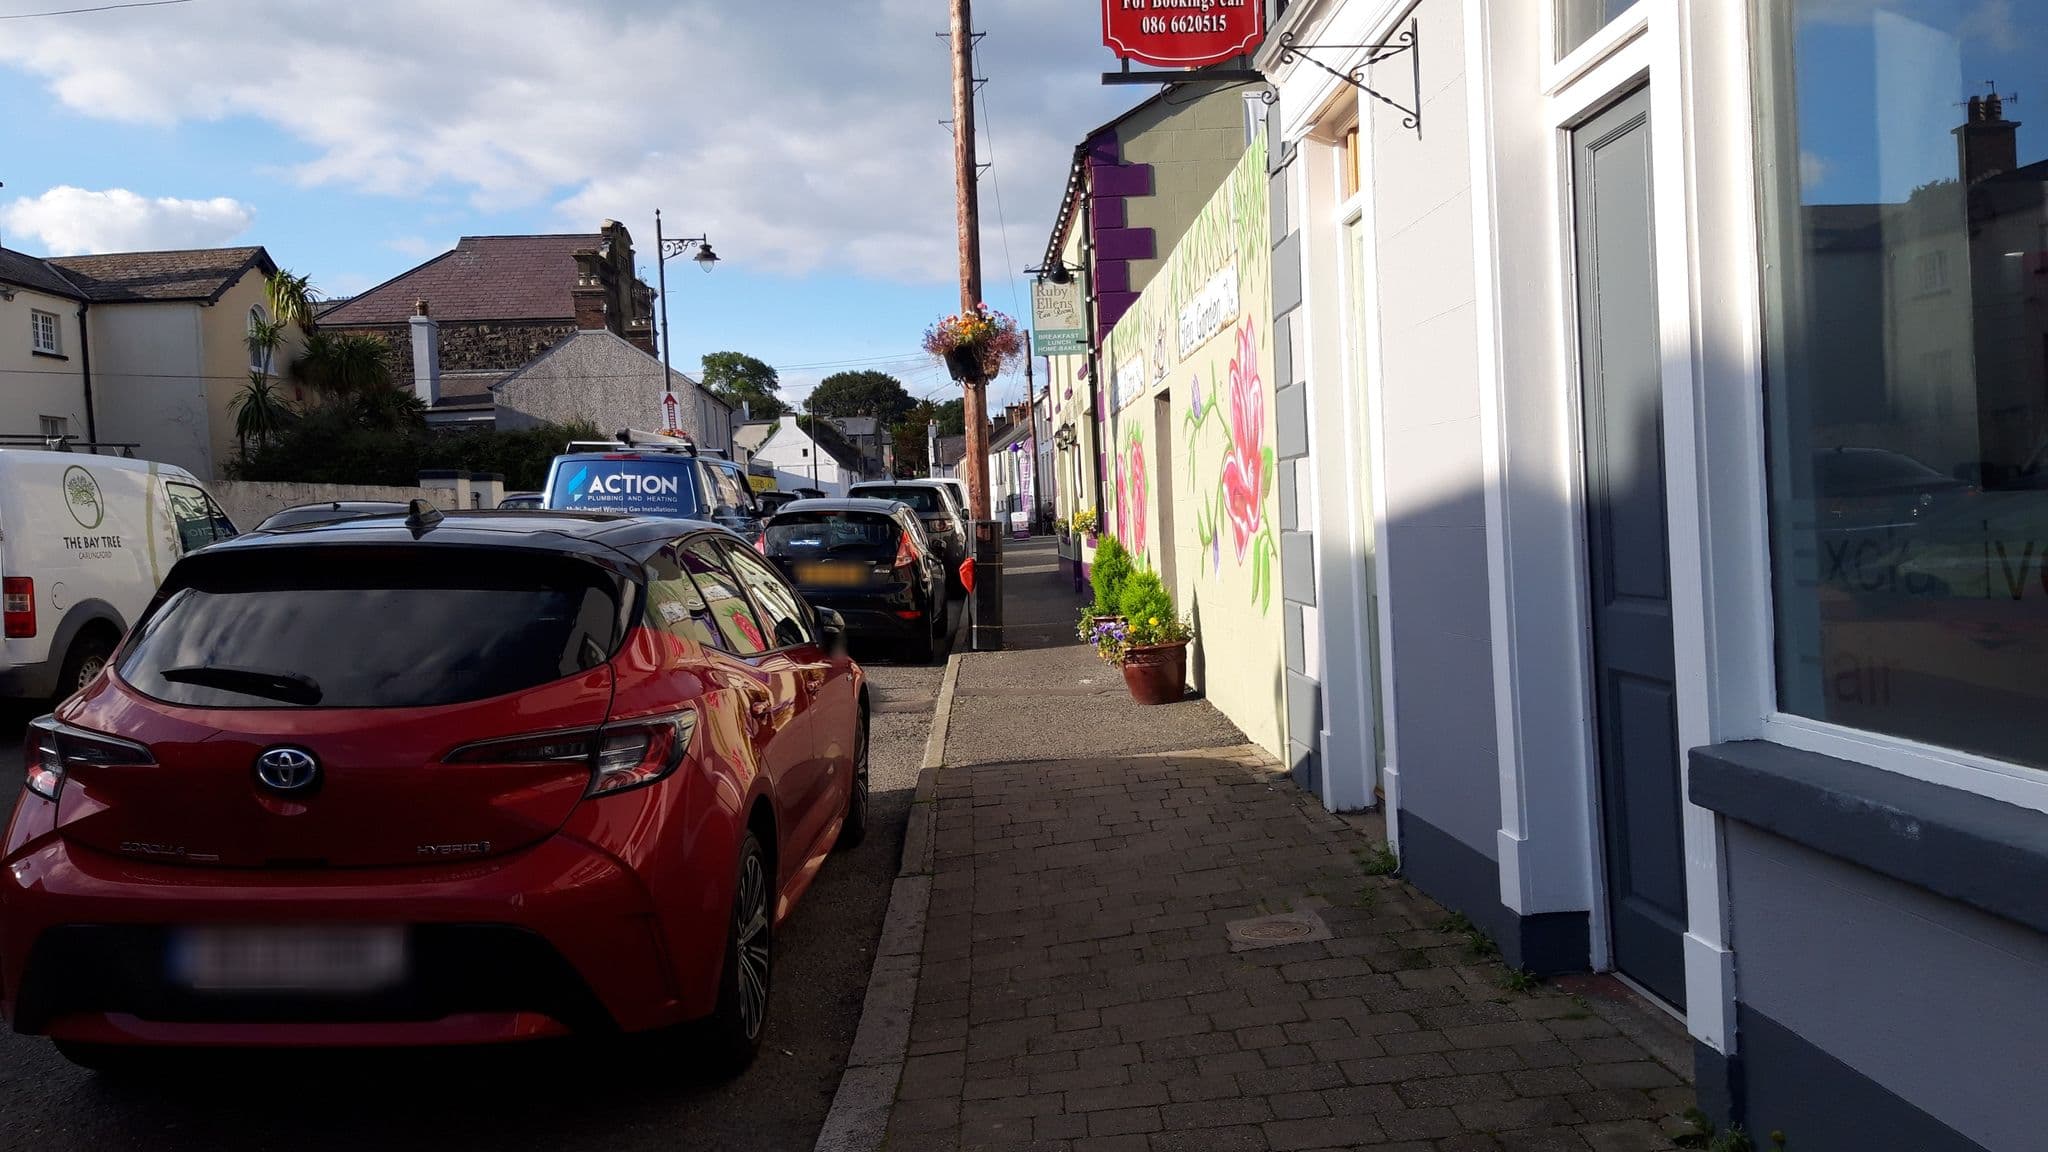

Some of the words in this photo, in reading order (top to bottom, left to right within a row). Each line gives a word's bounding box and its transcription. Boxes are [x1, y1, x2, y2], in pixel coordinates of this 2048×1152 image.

[1142, 16, 1166, 34] 086
[1170, 14, 1227, 33] 6620515
[1036, 284, 1068, 300] Ruby
[1036, 297, 1073, 310] Ellens
[588, 474, 678, 494] ACTION
[646, 495, 678, 503] HEATING
[602, 506, 628, 514] Winning
[63, 536, 83, 550] THE
[83, 536, 100, 549] BAY
[101, 535, 122, 549] TREE
[416, 842, 481, 856] HYBRID
